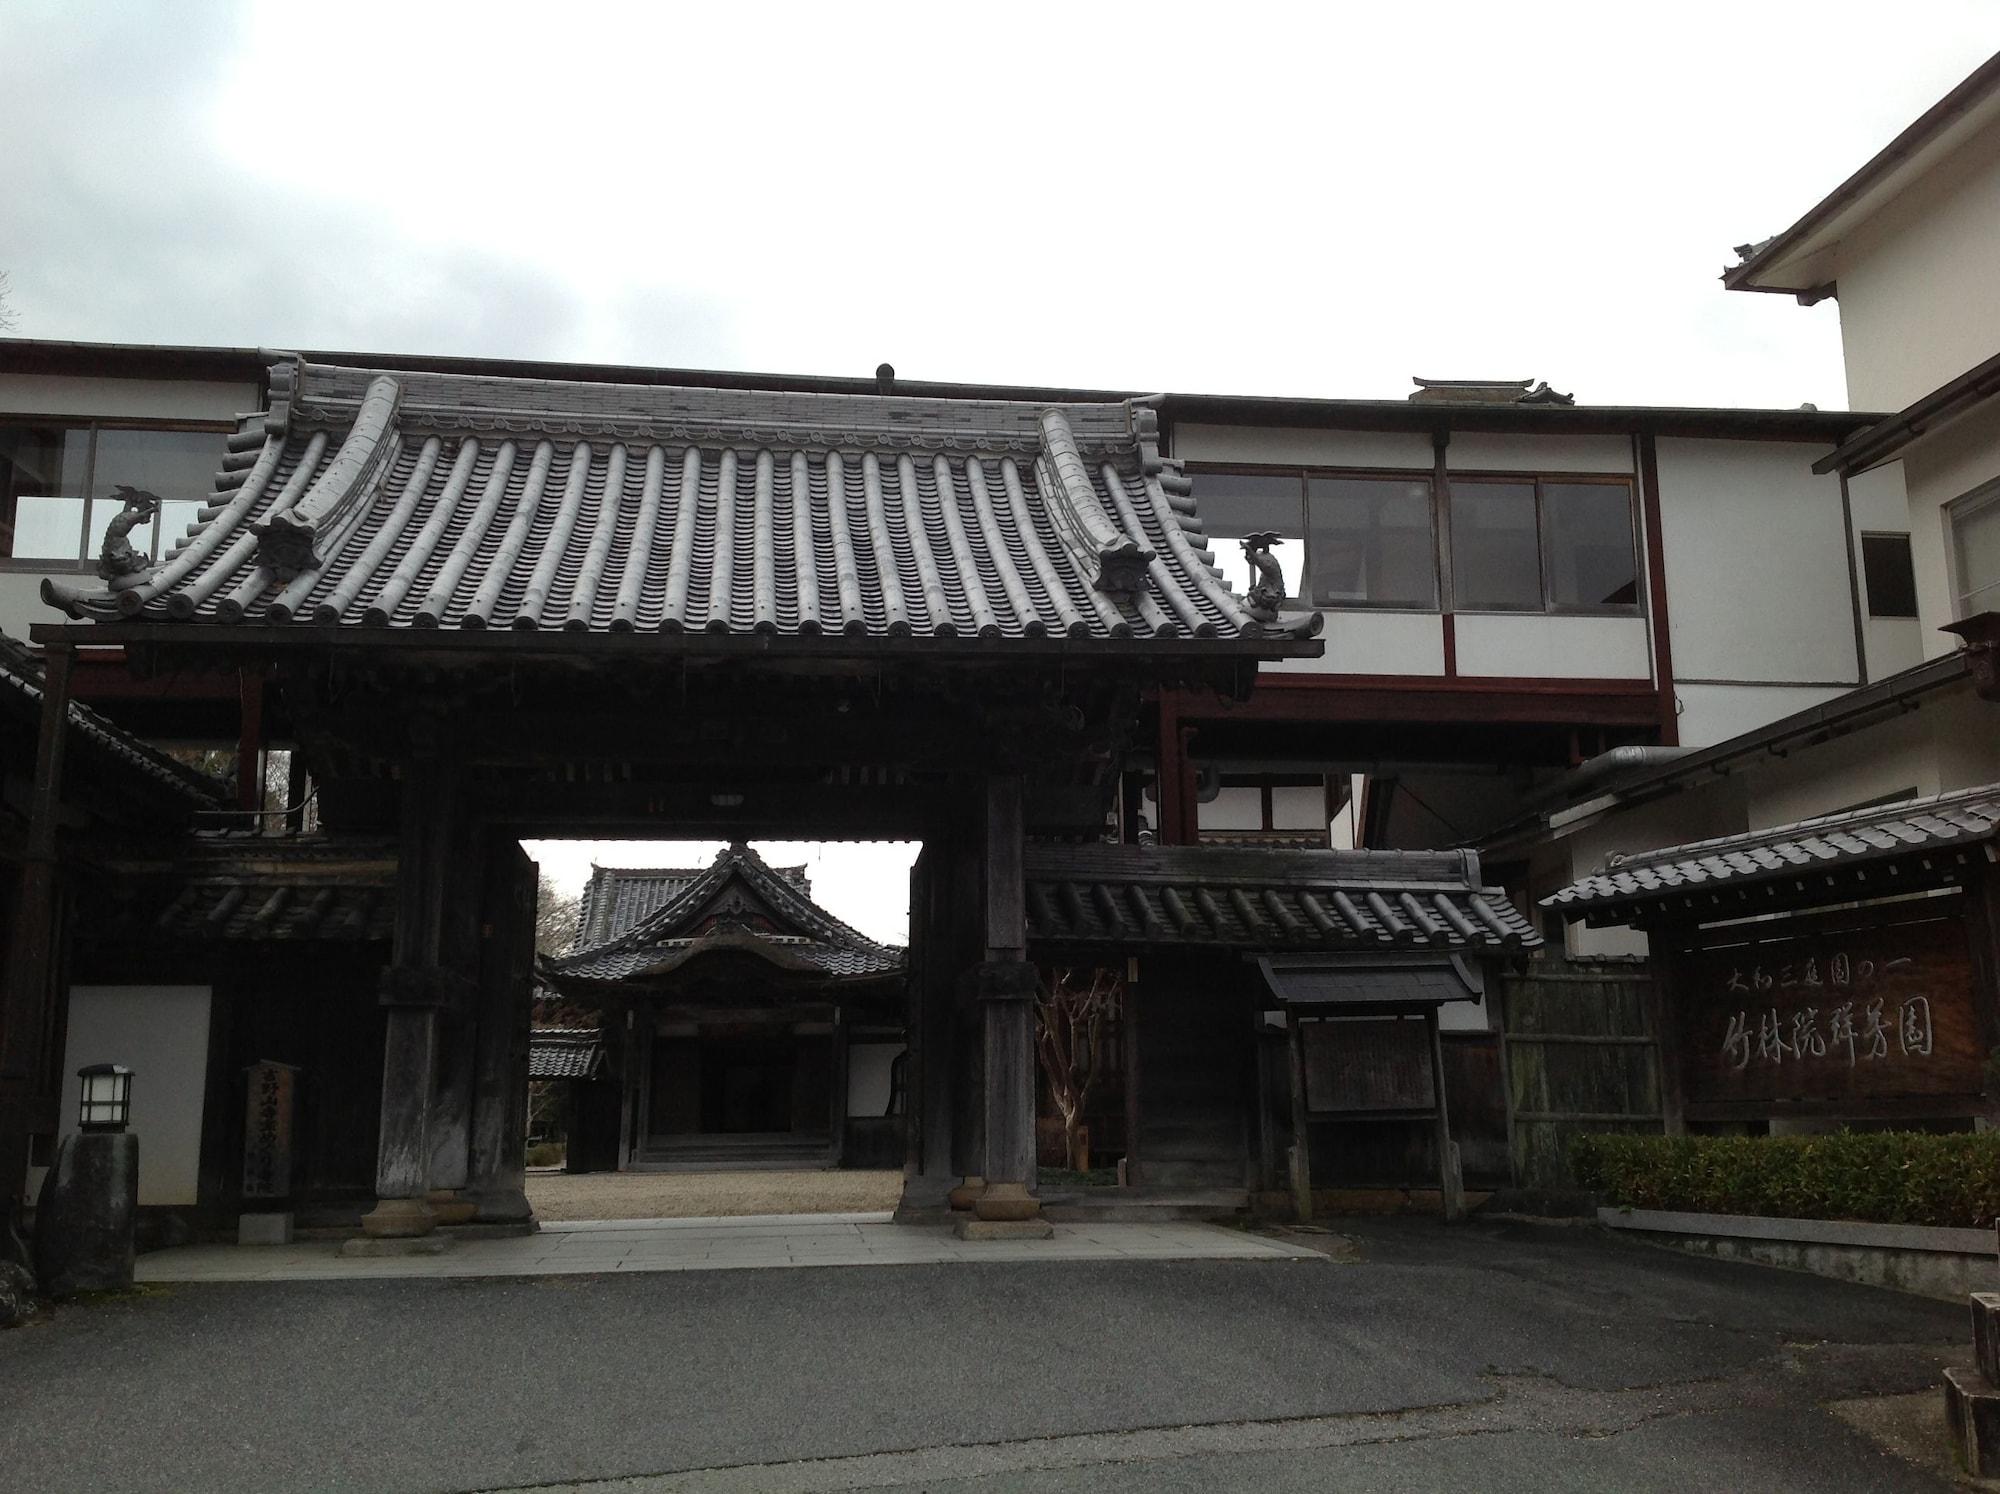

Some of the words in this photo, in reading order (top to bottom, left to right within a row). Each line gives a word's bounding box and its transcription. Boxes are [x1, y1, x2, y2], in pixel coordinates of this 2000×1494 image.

[1726, 953, 1912, 991] 大和三庭園の一
[1721, 996, 1932, 1069] 竹林院群芳園
